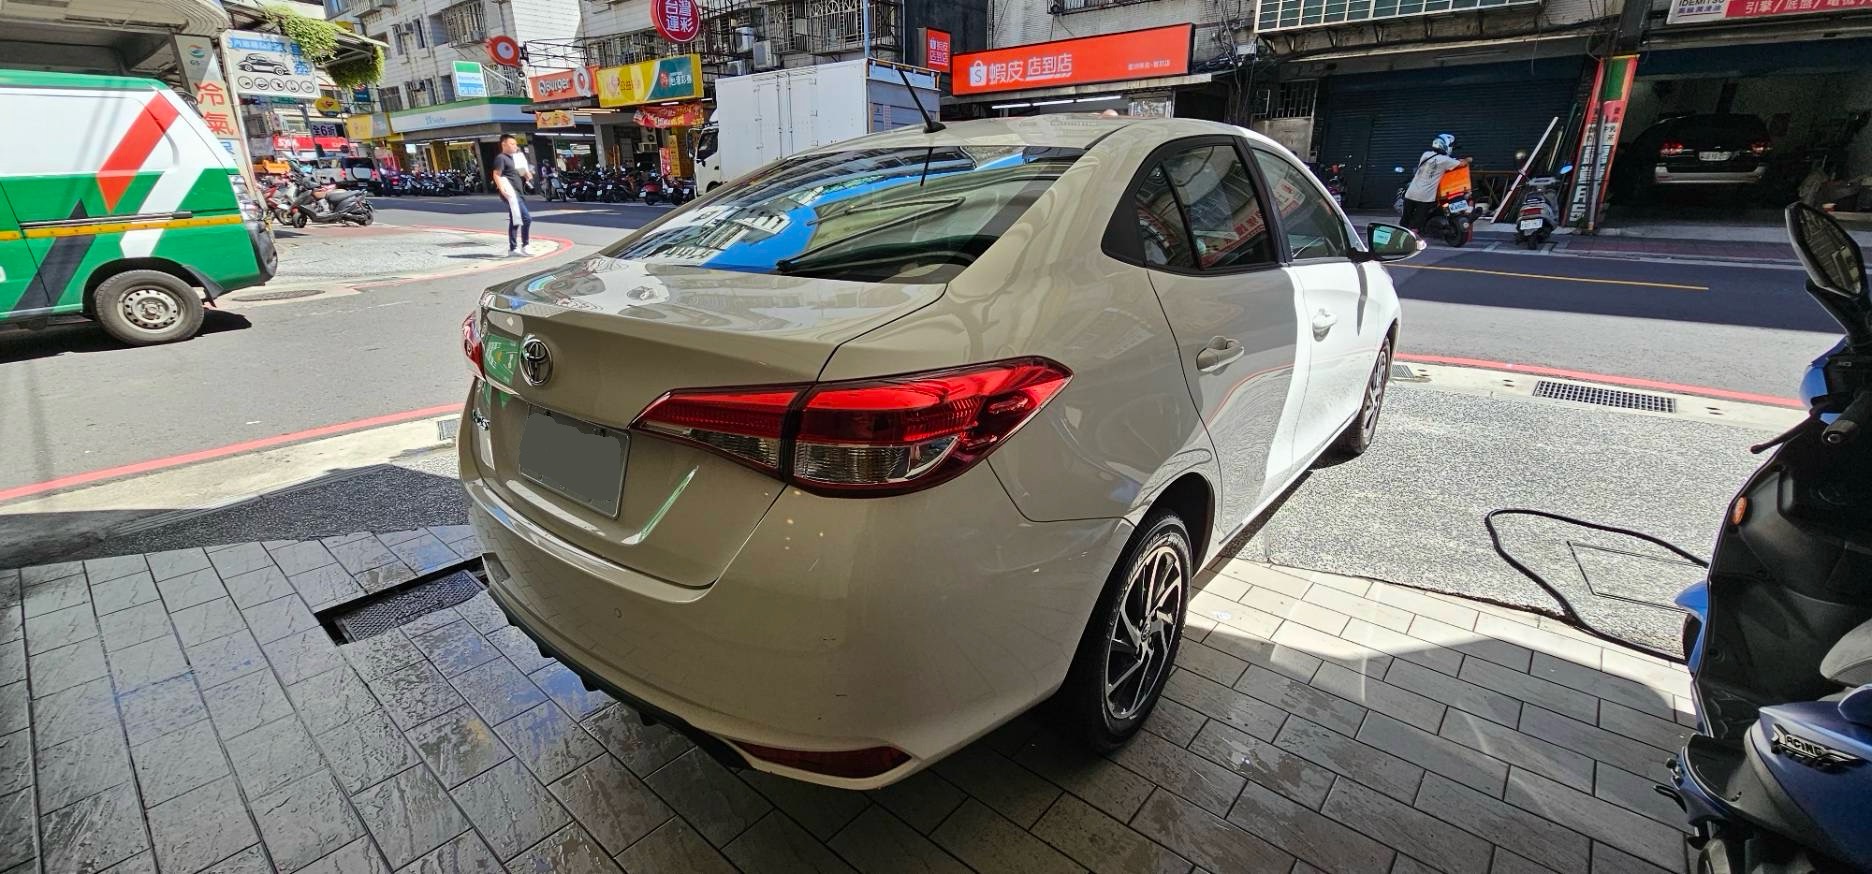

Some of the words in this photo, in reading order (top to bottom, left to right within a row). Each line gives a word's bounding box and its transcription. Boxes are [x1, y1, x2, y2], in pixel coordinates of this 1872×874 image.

[666, 15, 694, 33] 運彩
[988, 60, 1025, 85] 蝦皮
[1027, 53, 1073, 75] 店到店
[193, 81, 234, 136] 冷氣
